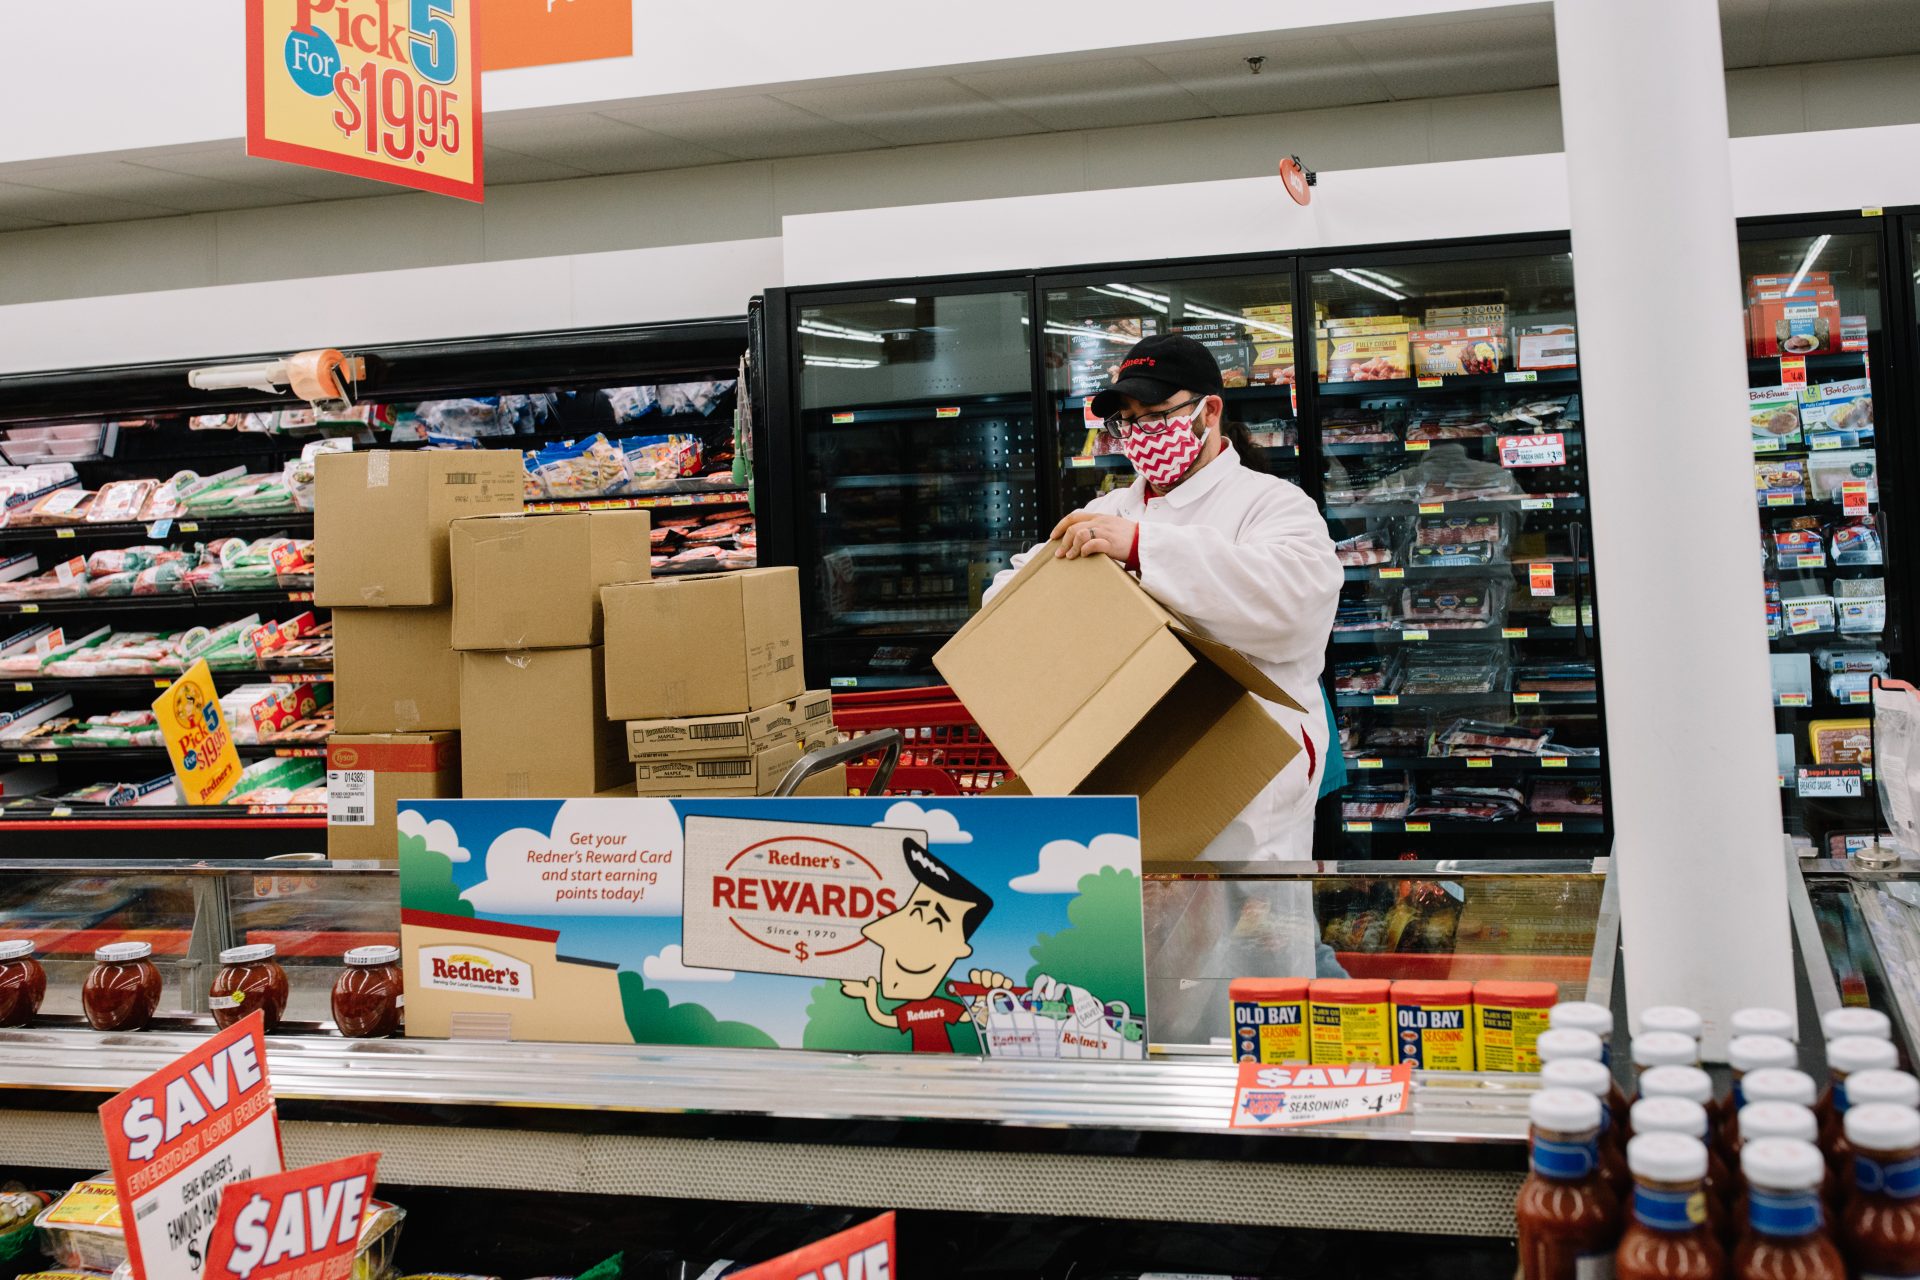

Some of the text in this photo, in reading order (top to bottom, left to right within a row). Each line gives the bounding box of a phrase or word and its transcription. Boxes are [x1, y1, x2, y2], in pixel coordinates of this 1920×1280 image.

[290, 0, 458, 85] Pick 5
[292, 38, 334, 79] For
[333, 61, 460, 165] $19.95
[178, 701, 219, 756] Pick 5
[196, 727, 227, 771] $19.95
[184, 753, 197, 769] For
[200, 762, 233, 800] Redner's
[570, 832, 627, 848] Get your
[527, 851, 672, 864] Redner's Reward Card
[767, 849, 841, 870] Redner's
[542, 869, 658, 885] and start earning
[556, 887, 645, 902] points today!
[712, 875, 898, 919] REWARDS
[766, 925, 837, 939] Since 1970
[432, 957, 519, 986] Redner's
[906, 1008, 945, 1022] Redner's
[1236, 1006, 1297, 1024] OLD BAY
[1398, 1010, 1460, 1028] OLD BAY
[1262, 1026, 1301, 1038] SEASONING
[1424, 1031, 1463, 1042] SEASONING
[1256, 1067, 1393, 1088] $AVE
[122, 1033, 262, 1162] $AVE
[1289, 1098, 1349, 1112] SEASONING
[127, 1134, 200, 1196] EVERYDAY
[202, 1112, 232, 1148] LOW
[168, 1203, 202, 1251] FAMOUS
[226, 1174, 368, 1280] $AVE
